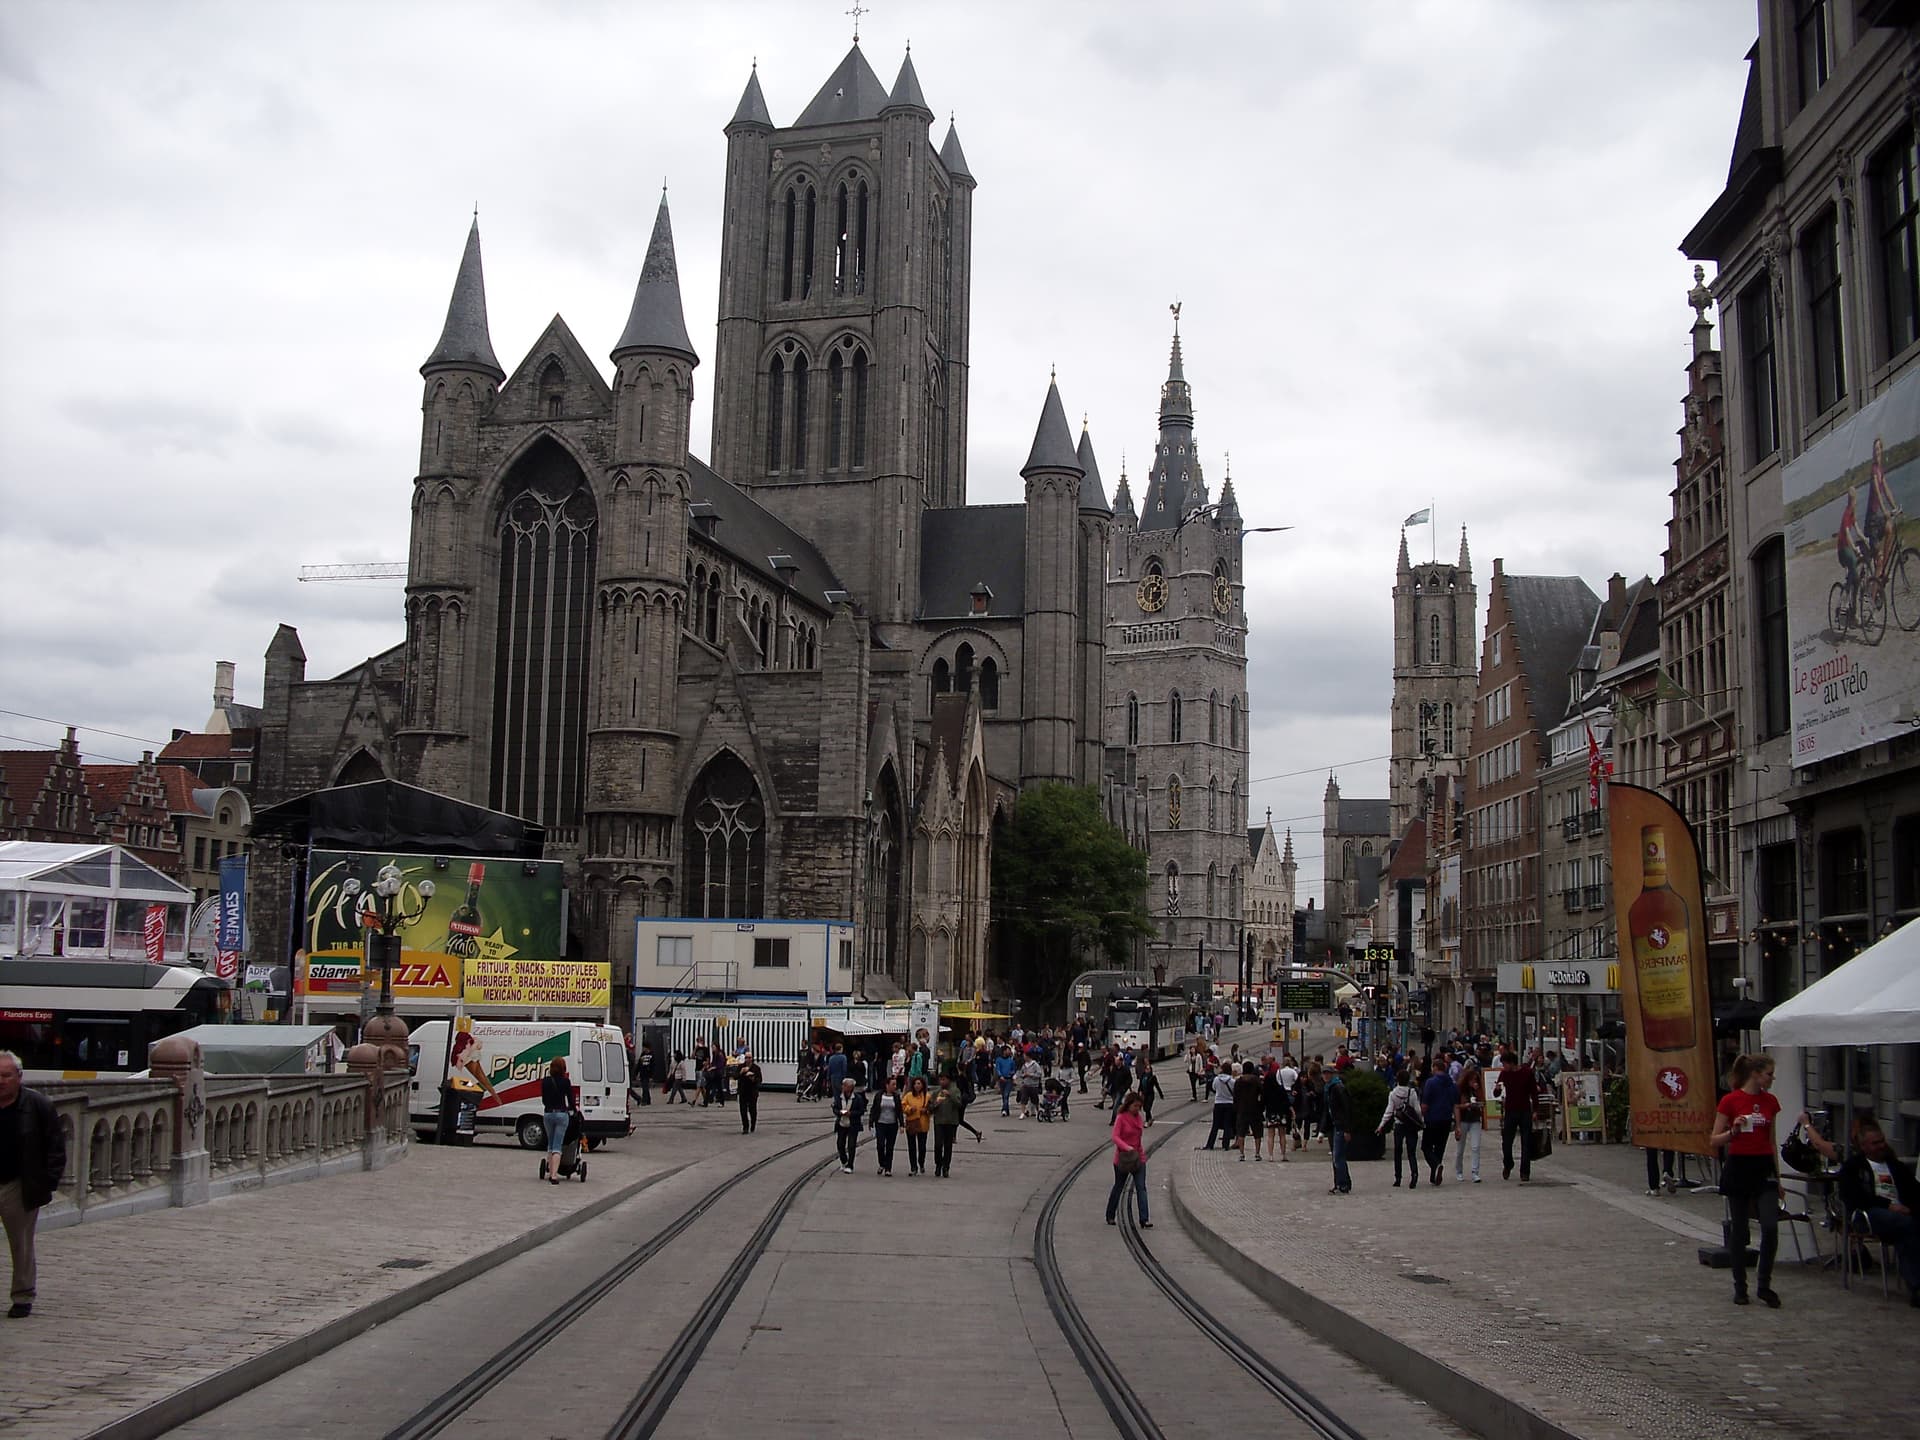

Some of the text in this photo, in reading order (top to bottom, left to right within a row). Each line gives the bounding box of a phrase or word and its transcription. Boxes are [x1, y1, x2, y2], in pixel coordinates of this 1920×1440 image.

[1794, 667, 1808, 695] Le
[1810, 649, 1849, 695] gamin
[1823, 662, 1868, 705] au vélo
[225, 891, 240, 929] MAES
[1364, 949, 1395, 960] 13:31
[310, 964, 361, 979] sbarro
[390, 963, 453, 987] ZZA
[477, 962, 598, 976] FRITUUR SNACKS STOOFVLEES
[466, 975, 607, 990] HAMBURGER BRAADWORST HOT-DOG
[1548, 970, 1587, 984] McDonald's
[483, 989, 591, 1003] MEXICANO CHICKENBURGER
[490, 1054, 551, 1081] Pierin
